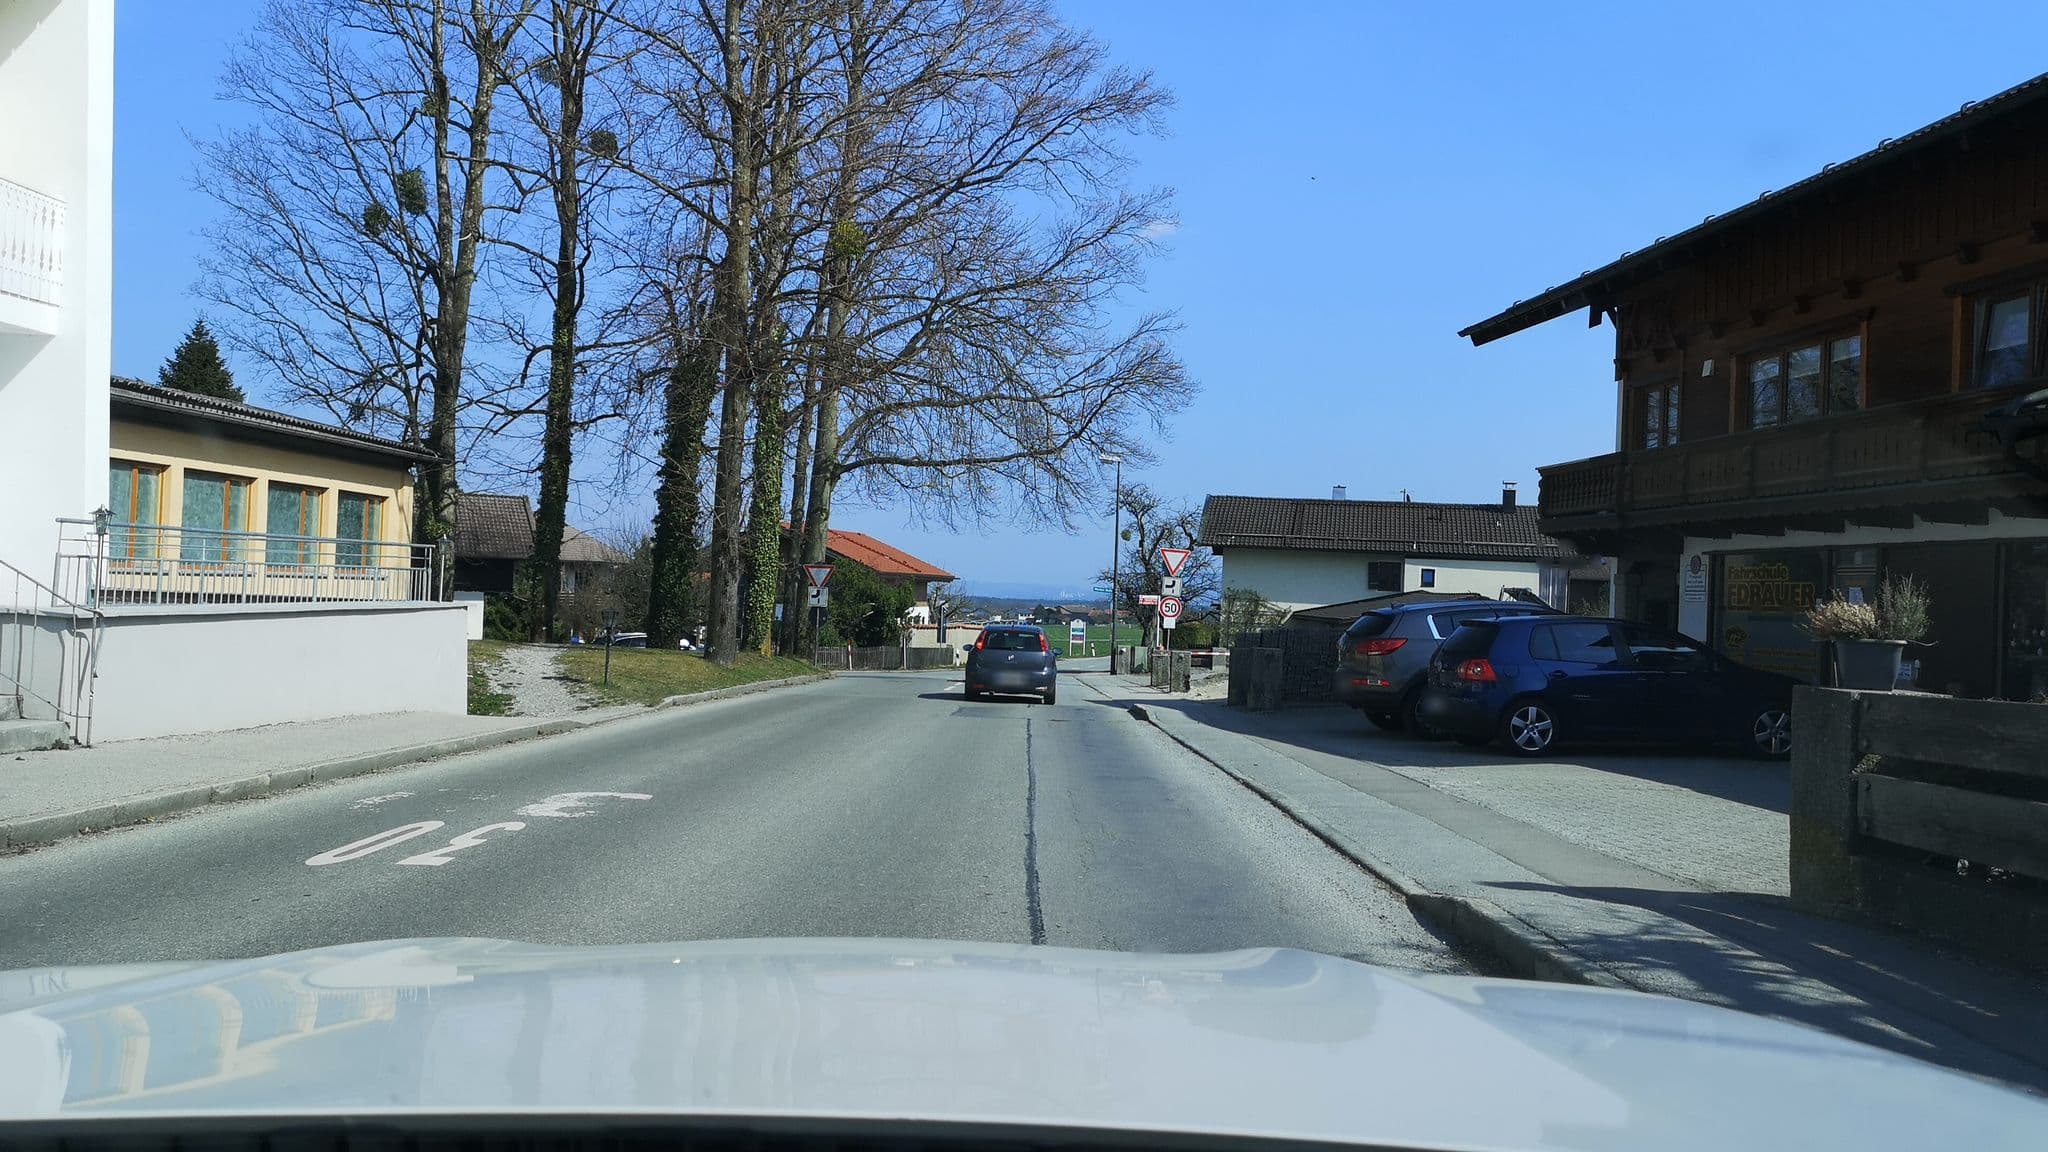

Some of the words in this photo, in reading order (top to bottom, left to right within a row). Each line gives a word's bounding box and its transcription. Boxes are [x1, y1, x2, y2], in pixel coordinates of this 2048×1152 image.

[1728, 563, 1789, 580] Fahrschule
[1164, 602, 1177, 613] 50
[304, 820, 526, 866] 30
